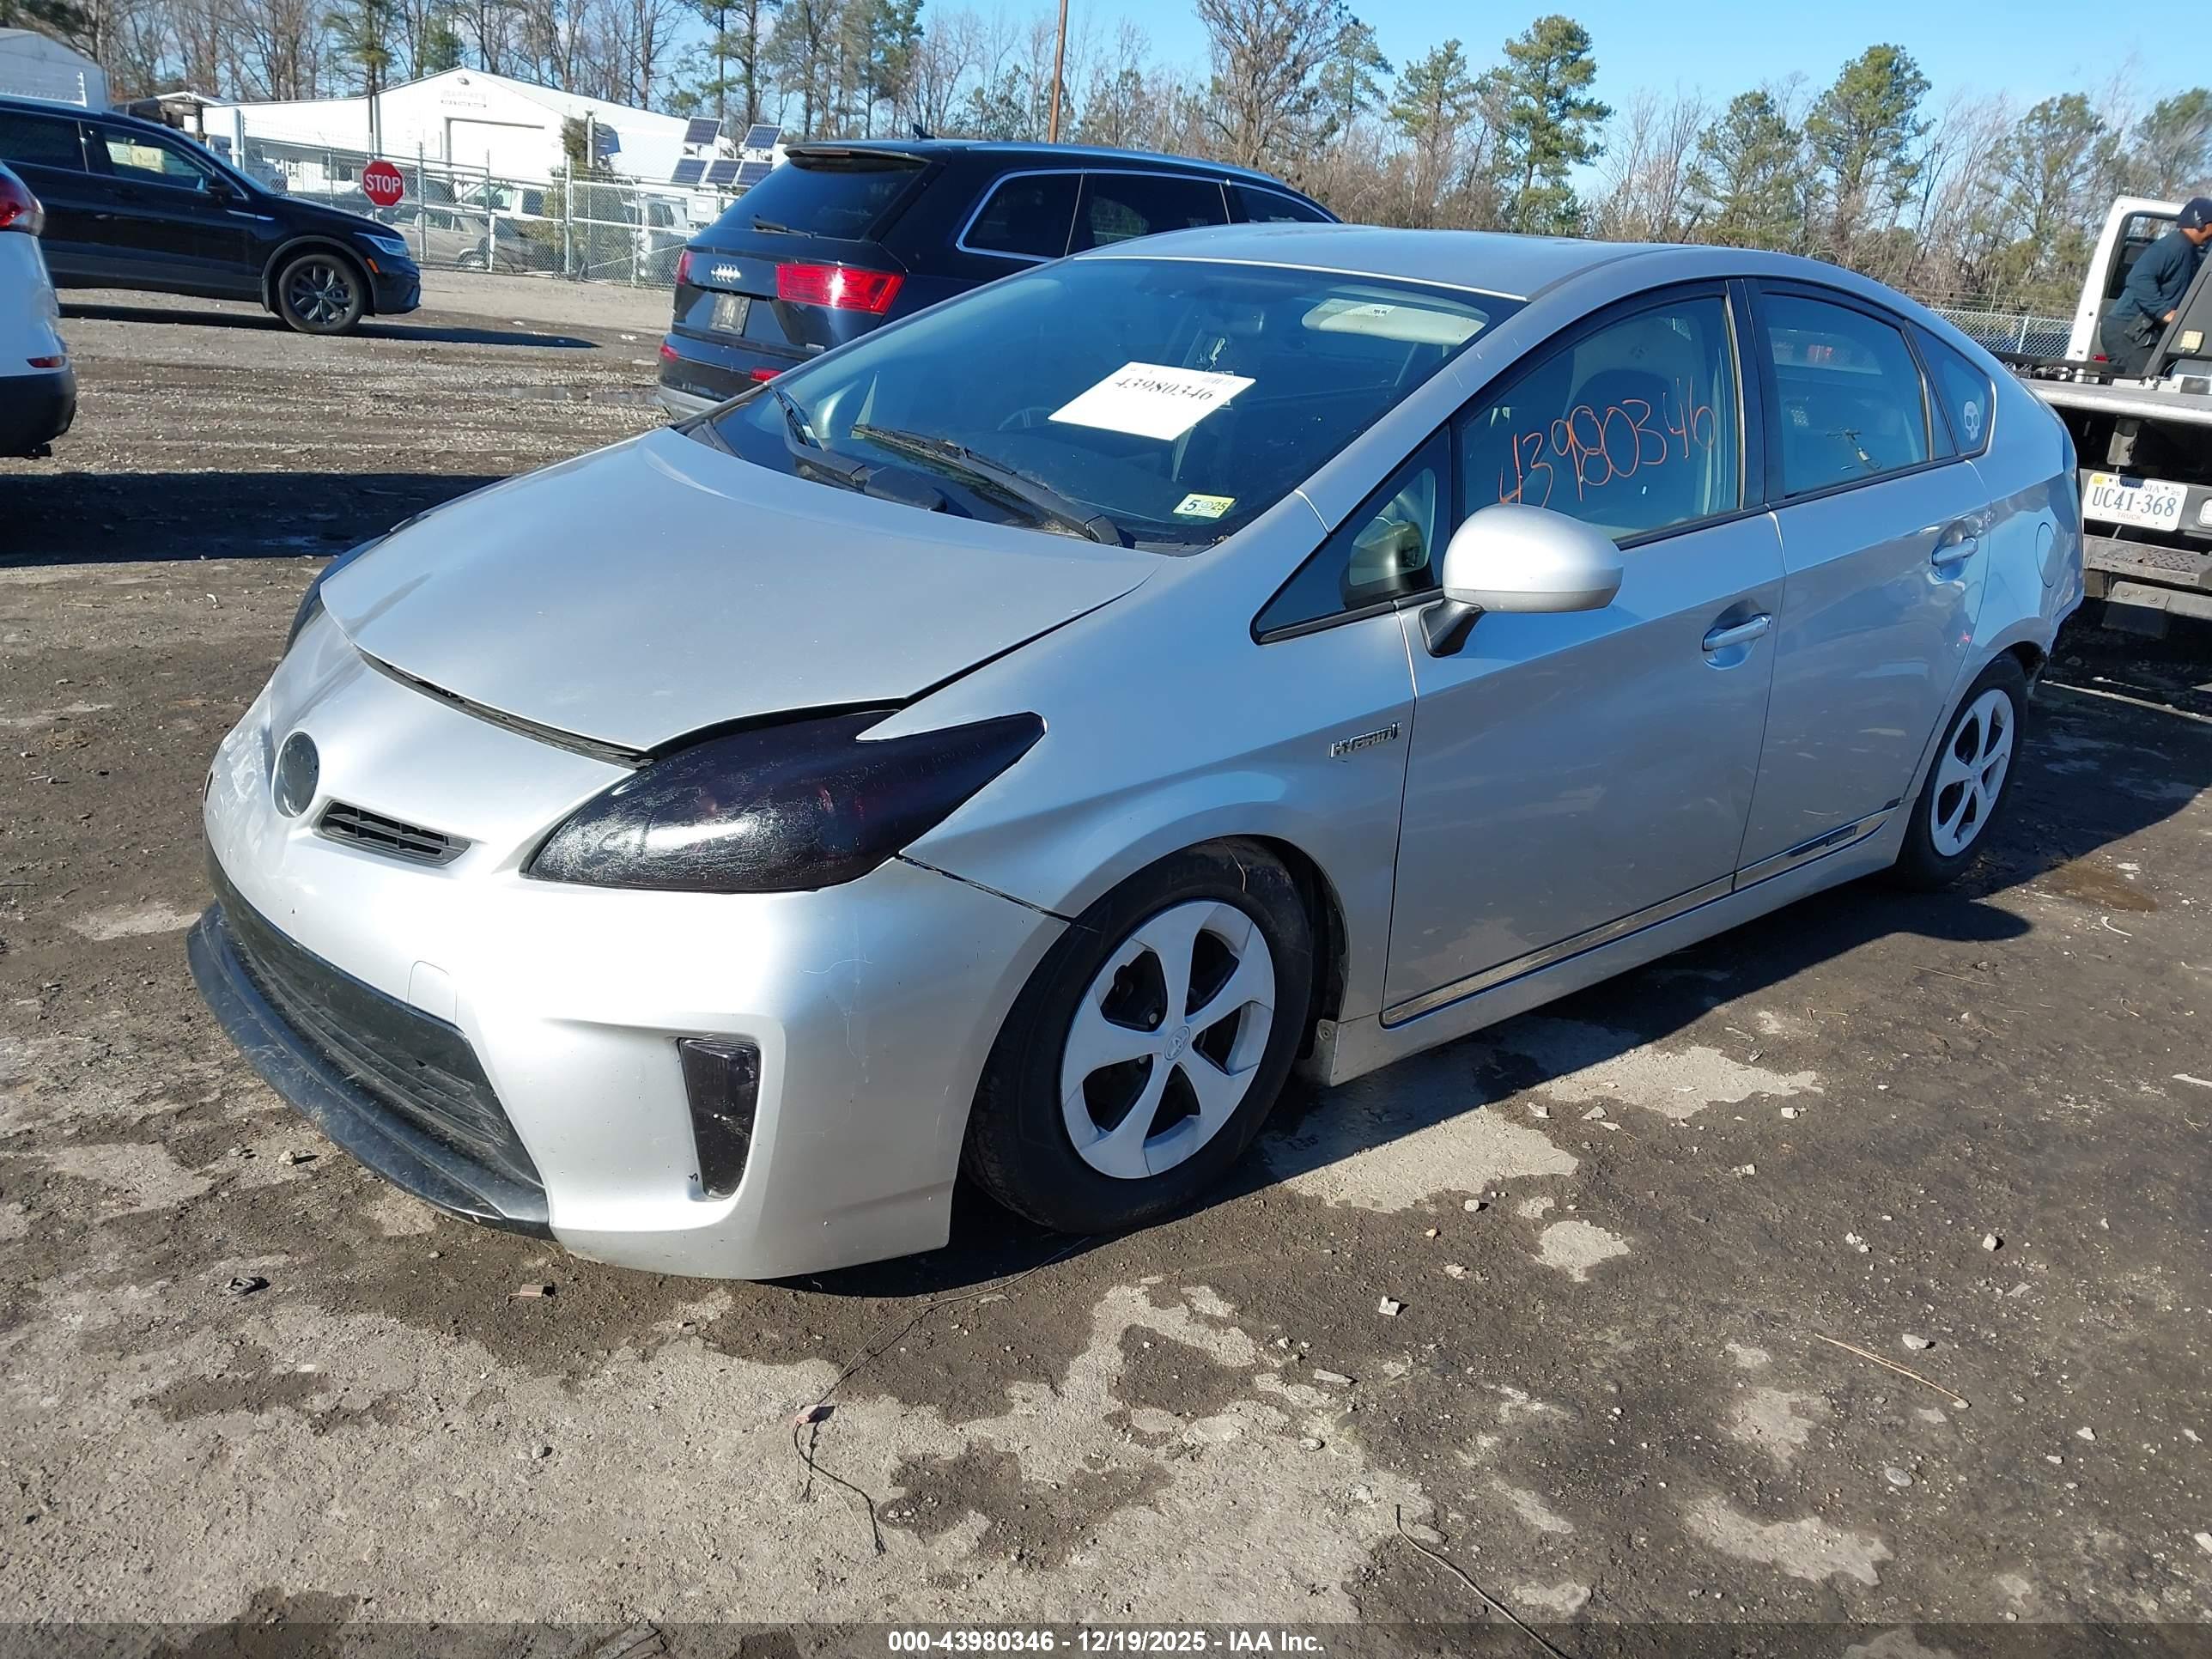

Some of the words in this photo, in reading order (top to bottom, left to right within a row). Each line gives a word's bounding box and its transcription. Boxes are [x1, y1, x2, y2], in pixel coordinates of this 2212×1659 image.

[366, 173, 401, 193] STOP
[1115, 377, 1213, 401] 43980346
[1498, 376, 1716, 508] 43980346
[2092, 486, 2177, 517] UC41-368
